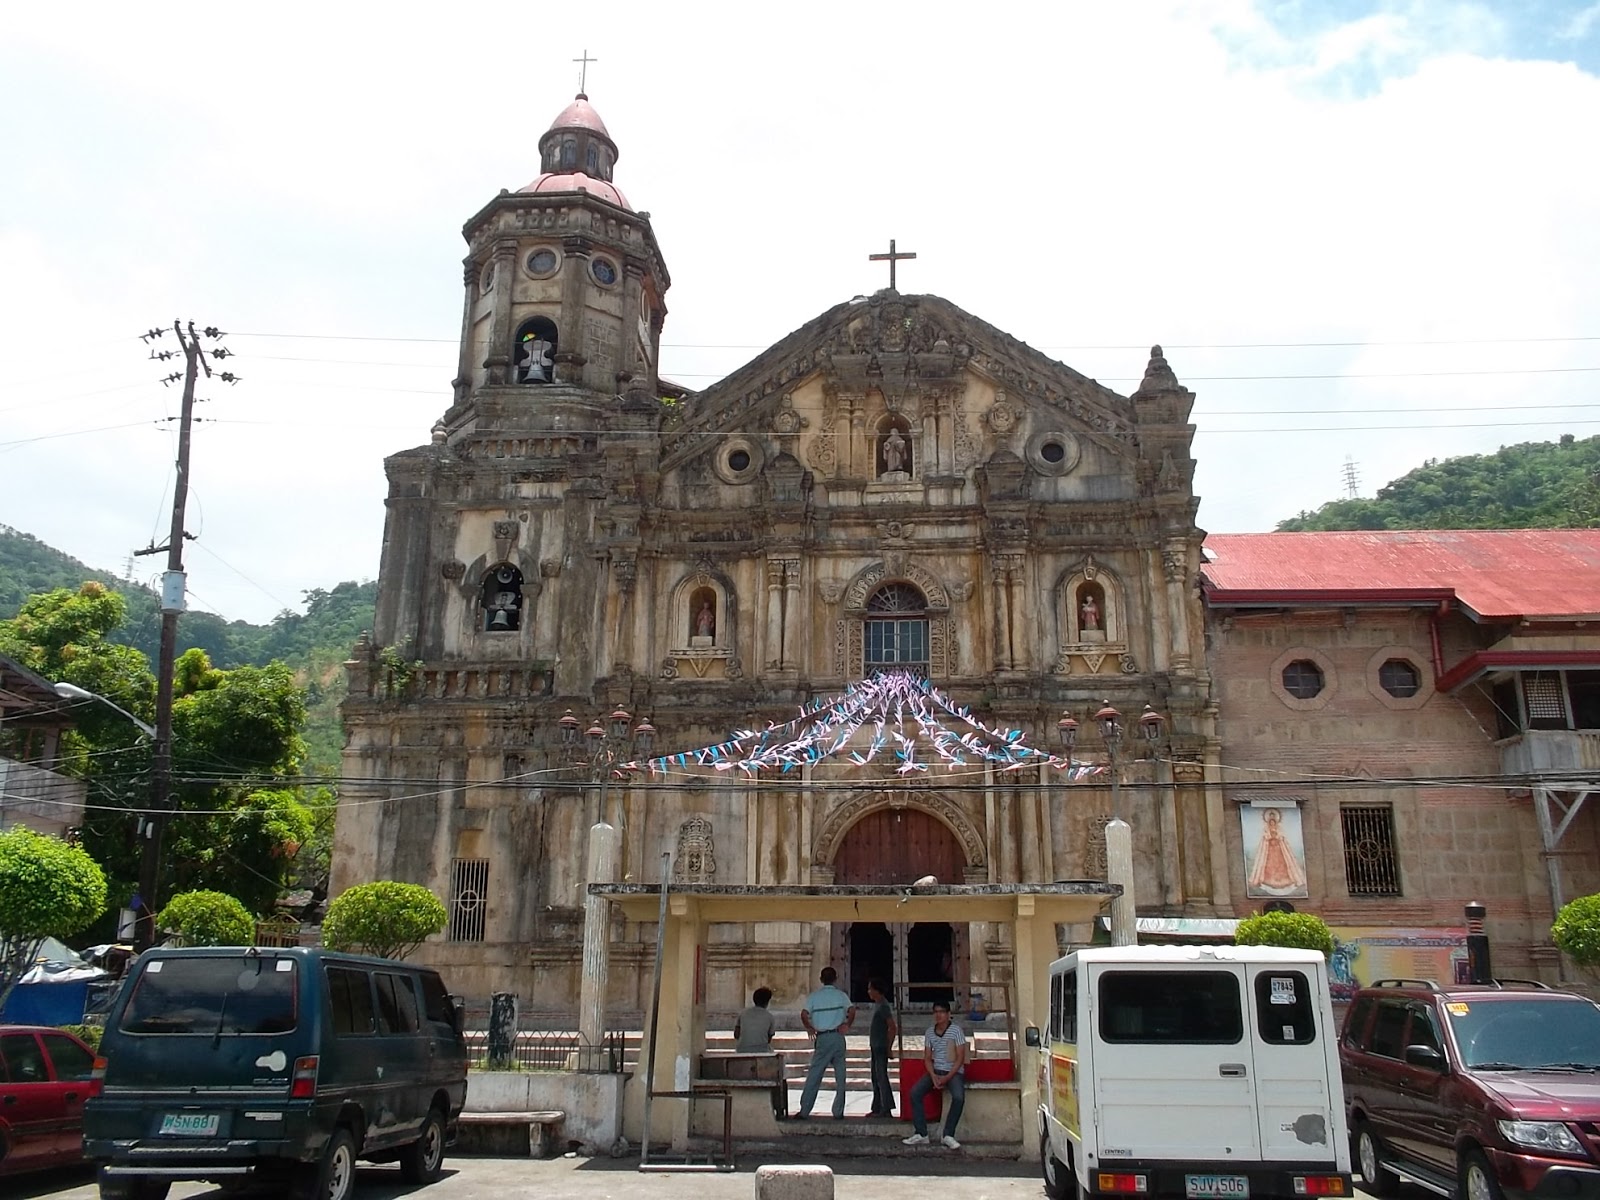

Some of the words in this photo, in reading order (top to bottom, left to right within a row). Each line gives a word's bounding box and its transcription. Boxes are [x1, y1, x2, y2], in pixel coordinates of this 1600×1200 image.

[1277, 981, 1293, 991] 7845
[1190, 1177, 1214, 1192] SJV
[1220, 1178, 1244, 1192] 506
